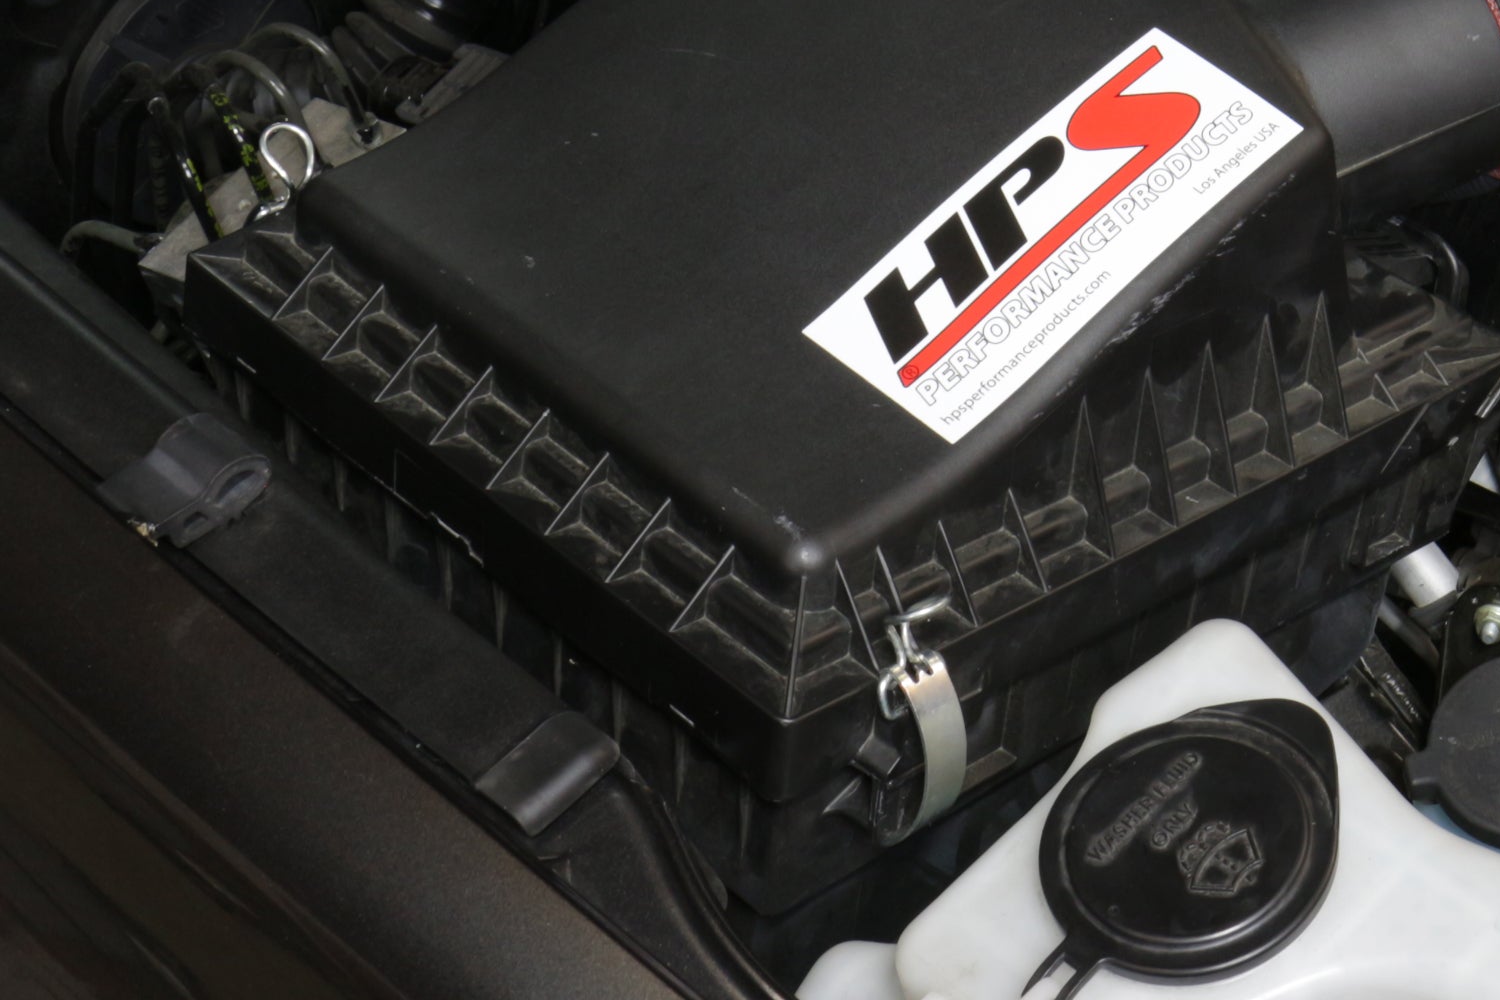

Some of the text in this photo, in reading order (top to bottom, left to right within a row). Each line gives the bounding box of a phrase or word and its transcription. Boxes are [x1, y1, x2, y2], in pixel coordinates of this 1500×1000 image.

[864, 44, 1201, 388] HPS
[1193, 121, 1280, 196] Los Angeles USA
[915, 101, 1255, 406] PERFORMANCE PRODUCTS
[939, 269, 1113, 428] hpsperformanceproducts.com
[1084, 750, 1203, 865] WASHER FLUID
[1148, 801, 1195, 850] ONLY
